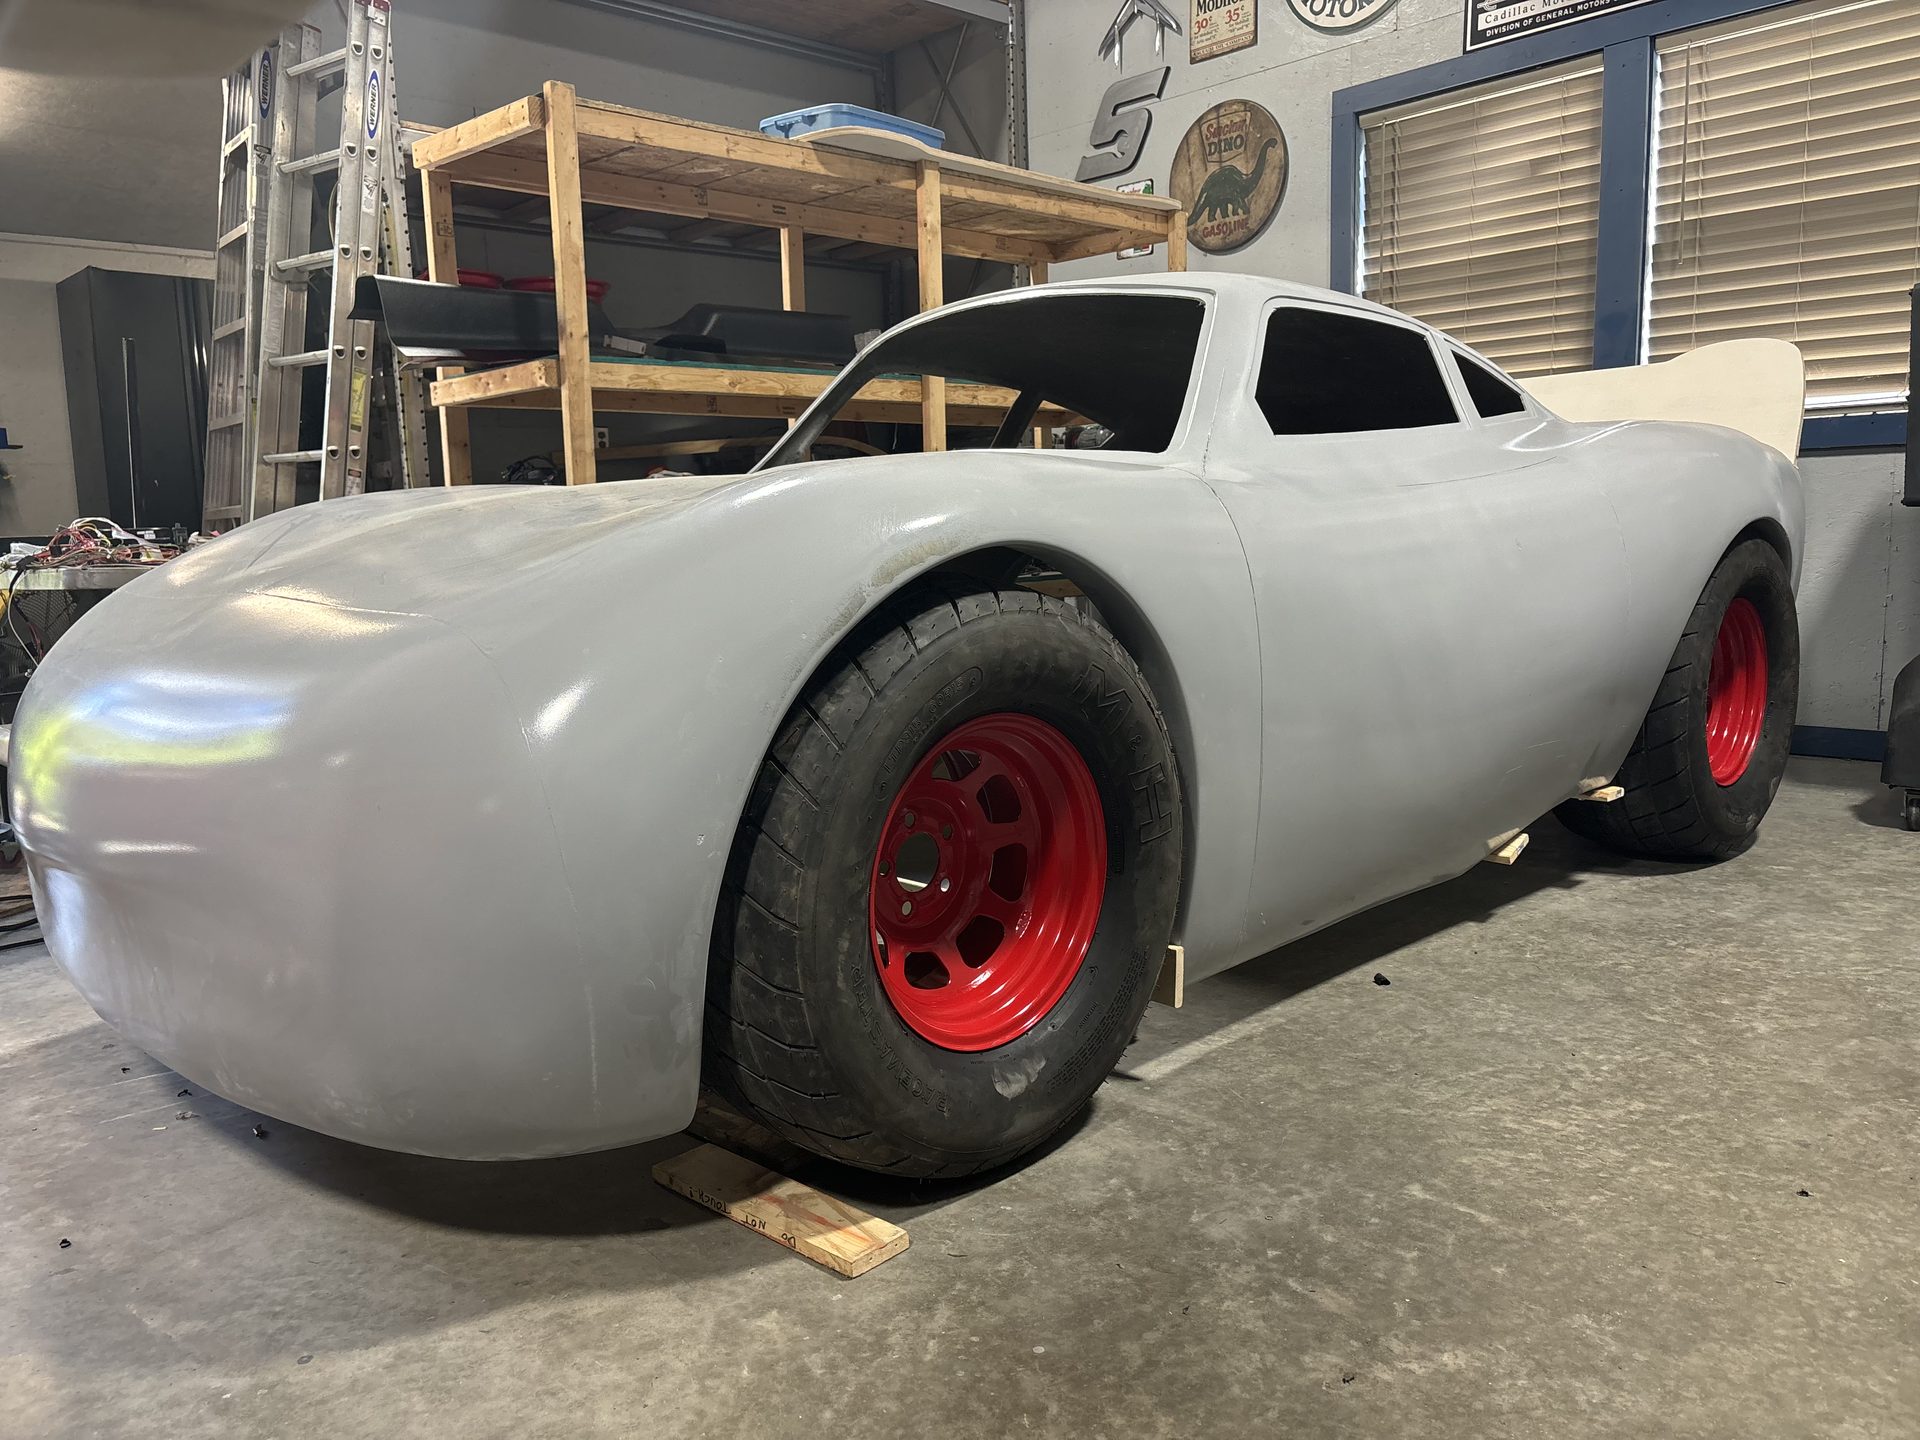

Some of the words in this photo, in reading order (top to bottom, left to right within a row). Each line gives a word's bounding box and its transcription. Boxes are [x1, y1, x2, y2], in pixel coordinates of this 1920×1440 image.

[1484, 4, 1536, 24] Cadillac
[1486, 21, 1520, 37] DIVISION
[1522, 18, 1534, 27] OF
[1535, 7, 1574, 23] GENERAL
[261, 63, 270, 105] WERNER
[369, 83, 377, 126] WERNER
[1207, 134, 1245, 157] DINO
[1202, 217, 1250, 239] GASOLINE
[740, 1215, 766, 1230] NOT
